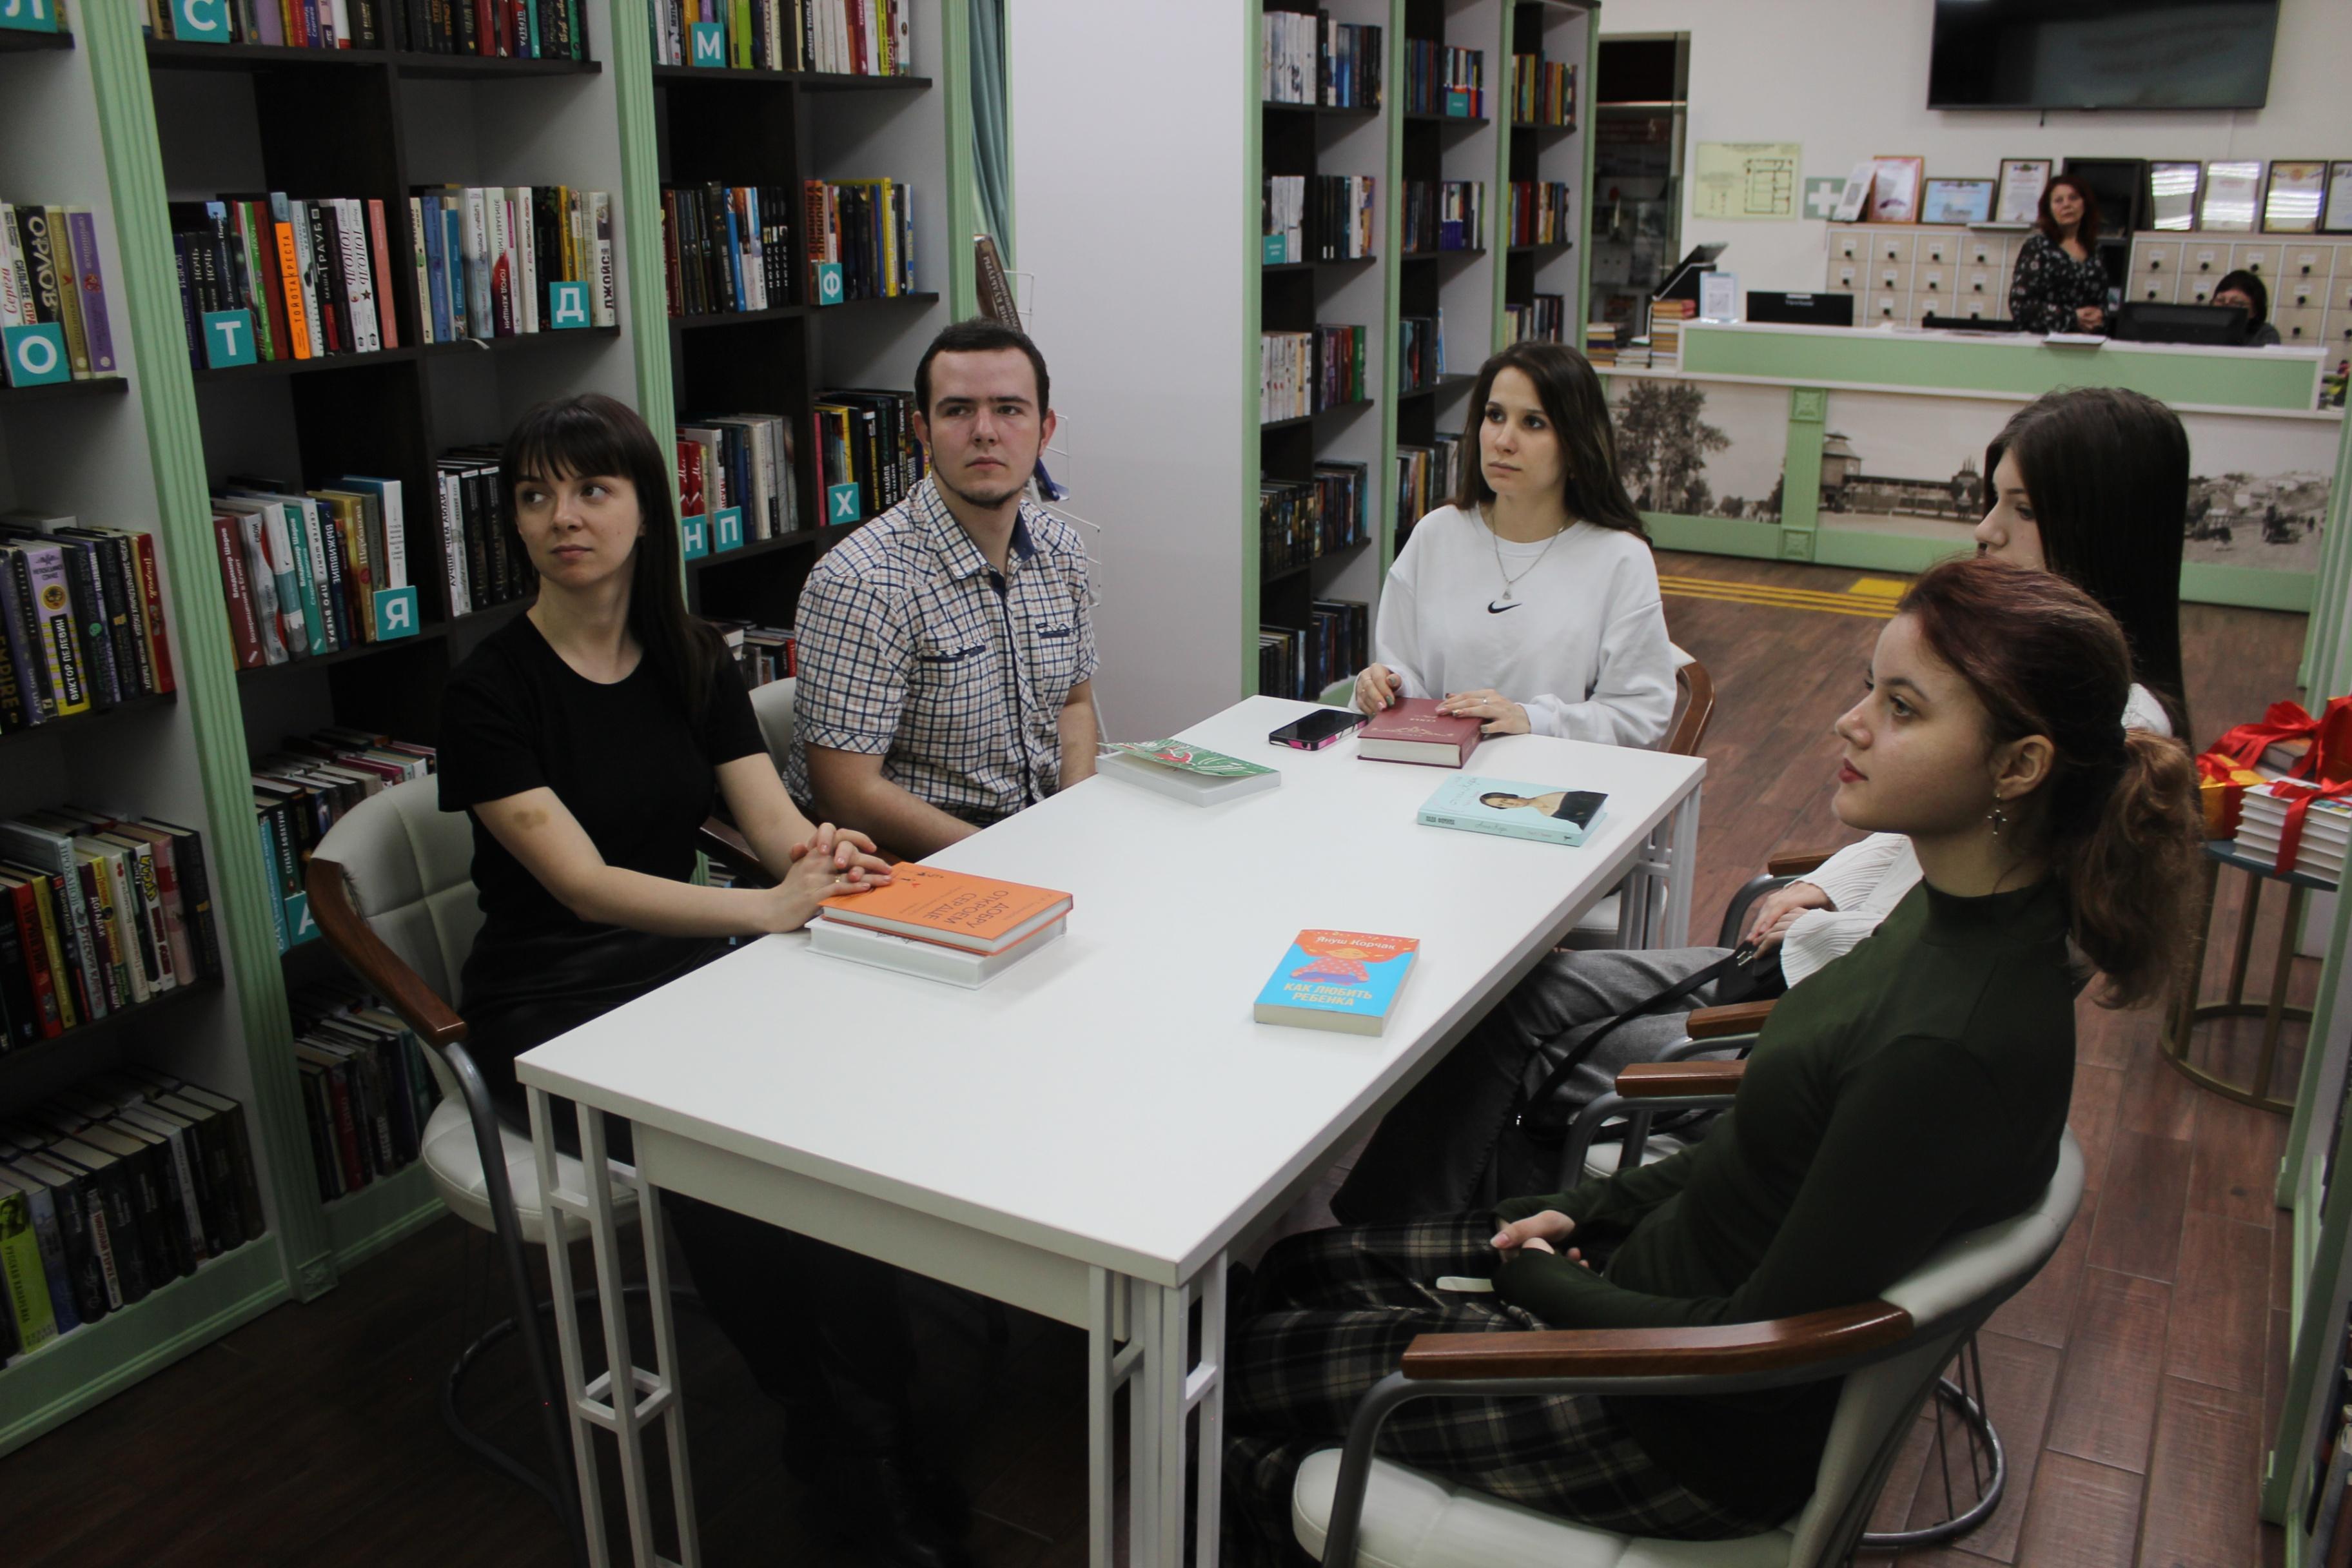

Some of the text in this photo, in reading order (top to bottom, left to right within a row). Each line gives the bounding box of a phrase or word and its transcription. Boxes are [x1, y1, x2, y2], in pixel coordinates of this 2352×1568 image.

[184, 0, 218, 31] С
[697, 30, 721, 60] М
[192, 248, 202, 281] НОЧЬ
[204, 248, 214, 282] НОЧЬ
[312, 221, 331, 299] МАША ТРАУБ
[339, 230, 356, 285] ТОПОЛЬ
[353, 230, 369, 285] ТОПОЛЬ
[284, 277, 301, 324] ТОЙОТА
[500, 267, 511, 330] ГОРОД ЖЕНЩИН
[600, 255, 614, 309] ДЖОЙС
[822, 271, 841, 298] Ф
[556, 288, 585, 323] Д
[17, 335, 58, 375] О
[215, 320, 242, 357] Т
[835, 490, 854, 517] Х
[308, 511, 324, 577] СЕРГЕЙ ШОЙГУ
[356, 505, 367, 564] Щербакова
[444, 527, 453, 548] ЧЕМ
[683, 523, 702, 553] Н
[720, 515, 738, 544] П
[221, 527, 240, 598] Владимир Шаров
[233, 558, 245, 584] Египет
[289, 517, 307, 587] Владимир Шаров
[324, 523, 339, 585] ВЫЖИВШИЕ
[119, 538, 142, 637] ЖИЗНЬ ЗАМЕЧАТЕЛЬНЫХ ЛЮДЕЙ
[240, 591, 258, 643] Возвращение
[320, 584, 335, 644] ПРО ВЧЕРА
[385, 597, 409, 631] Я
[55, 618, 79, 701] ВИКТОР ПЕЛЕВИН
[60, 844, 79, 910] ПРОХАНОВ
[140, 854, 159, 902] ЧИСЛА
[89, 896, 106, 937] ДОГАДКИ
[923, 892, 977, 920] СЕРДЦЕ
[944, 890, 1010, 925] ОТКРОЕМ
[966, 903, 1010, 929] ДОБРУ
[1315, 936, 1396, 950] Януш Корчак
[1284, 983, 1373, 1000] КАК ЛЮБИТЬ
[3, 1245, 30, 1323] РУССКАЯ КАНАРЕЙКА
